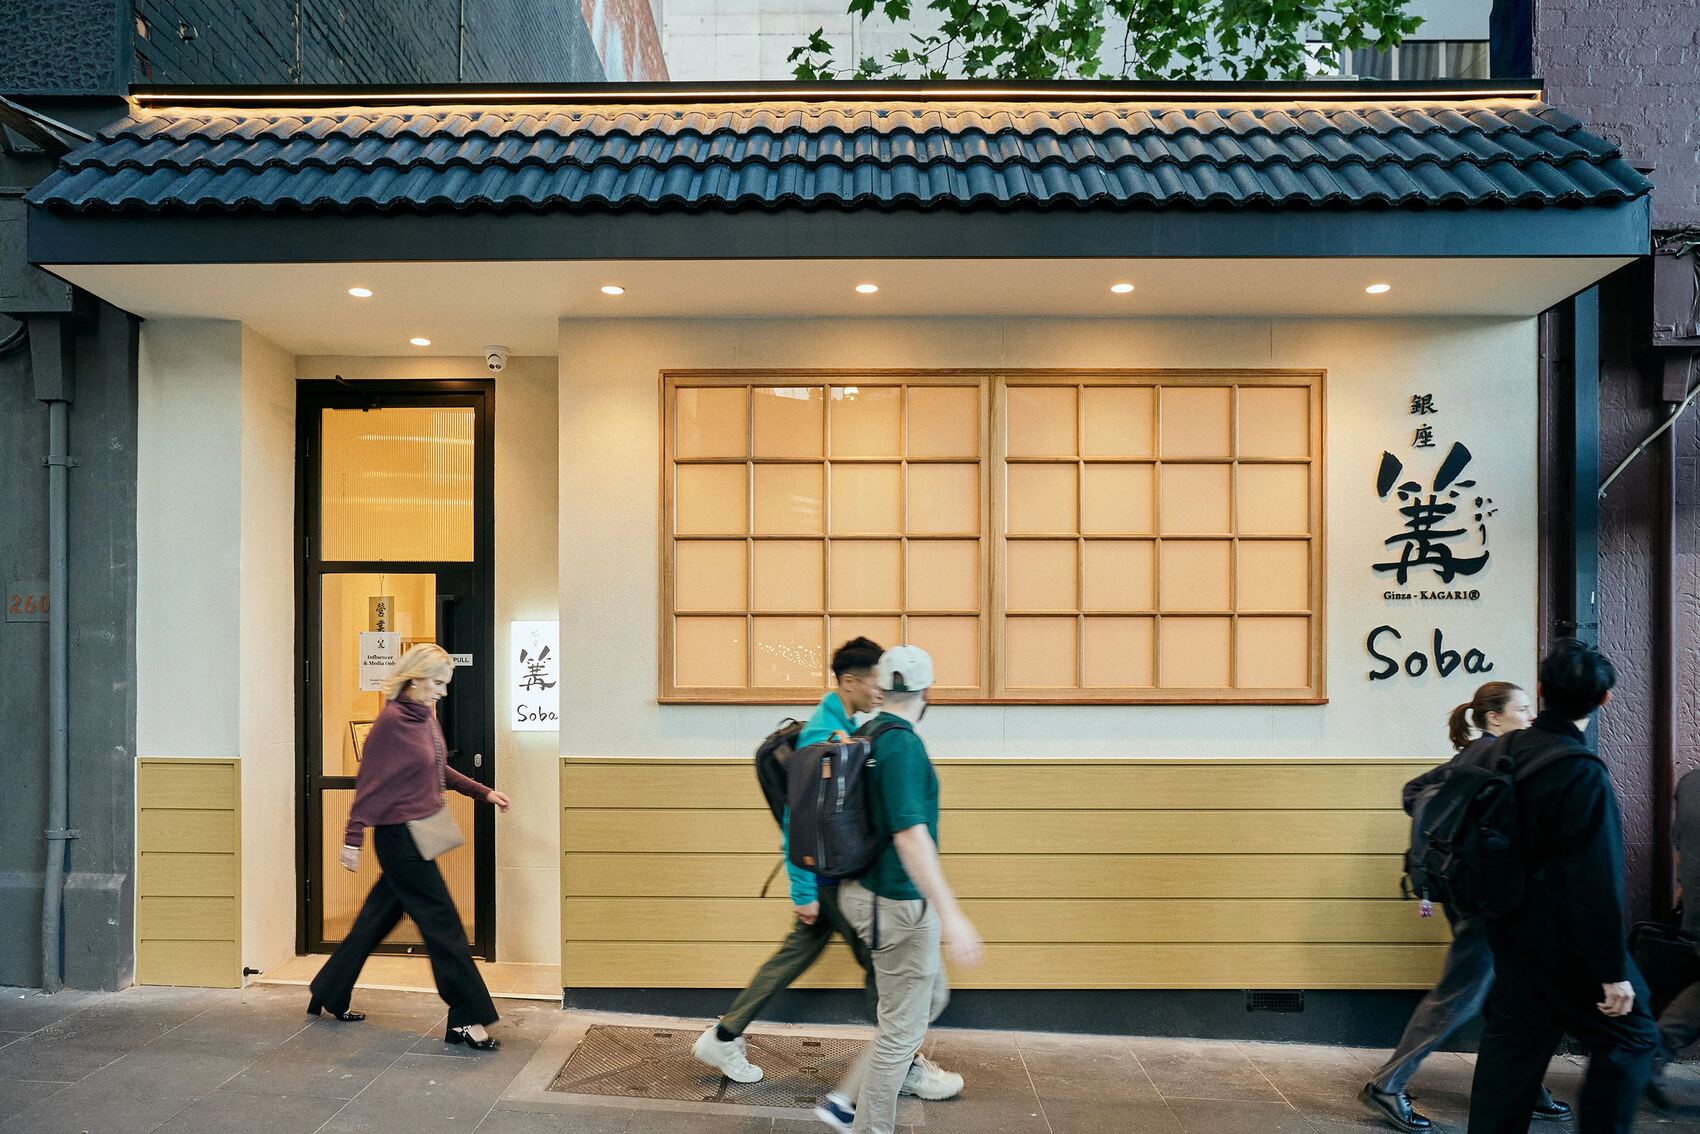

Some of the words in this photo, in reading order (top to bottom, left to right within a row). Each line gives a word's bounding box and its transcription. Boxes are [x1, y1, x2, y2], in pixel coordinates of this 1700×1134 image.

[1410, 393, 1439, 448] 銀座
[1371, 441, 1491, 585] 篝
[1474, 496, 1499, 546] かがり
[8, 592, 50, 614] 260
[1383, 591, 1412, 600] Ginza
[1367, 625, 1494, 681] Soba
[517, 704, 558, 722] Soba
